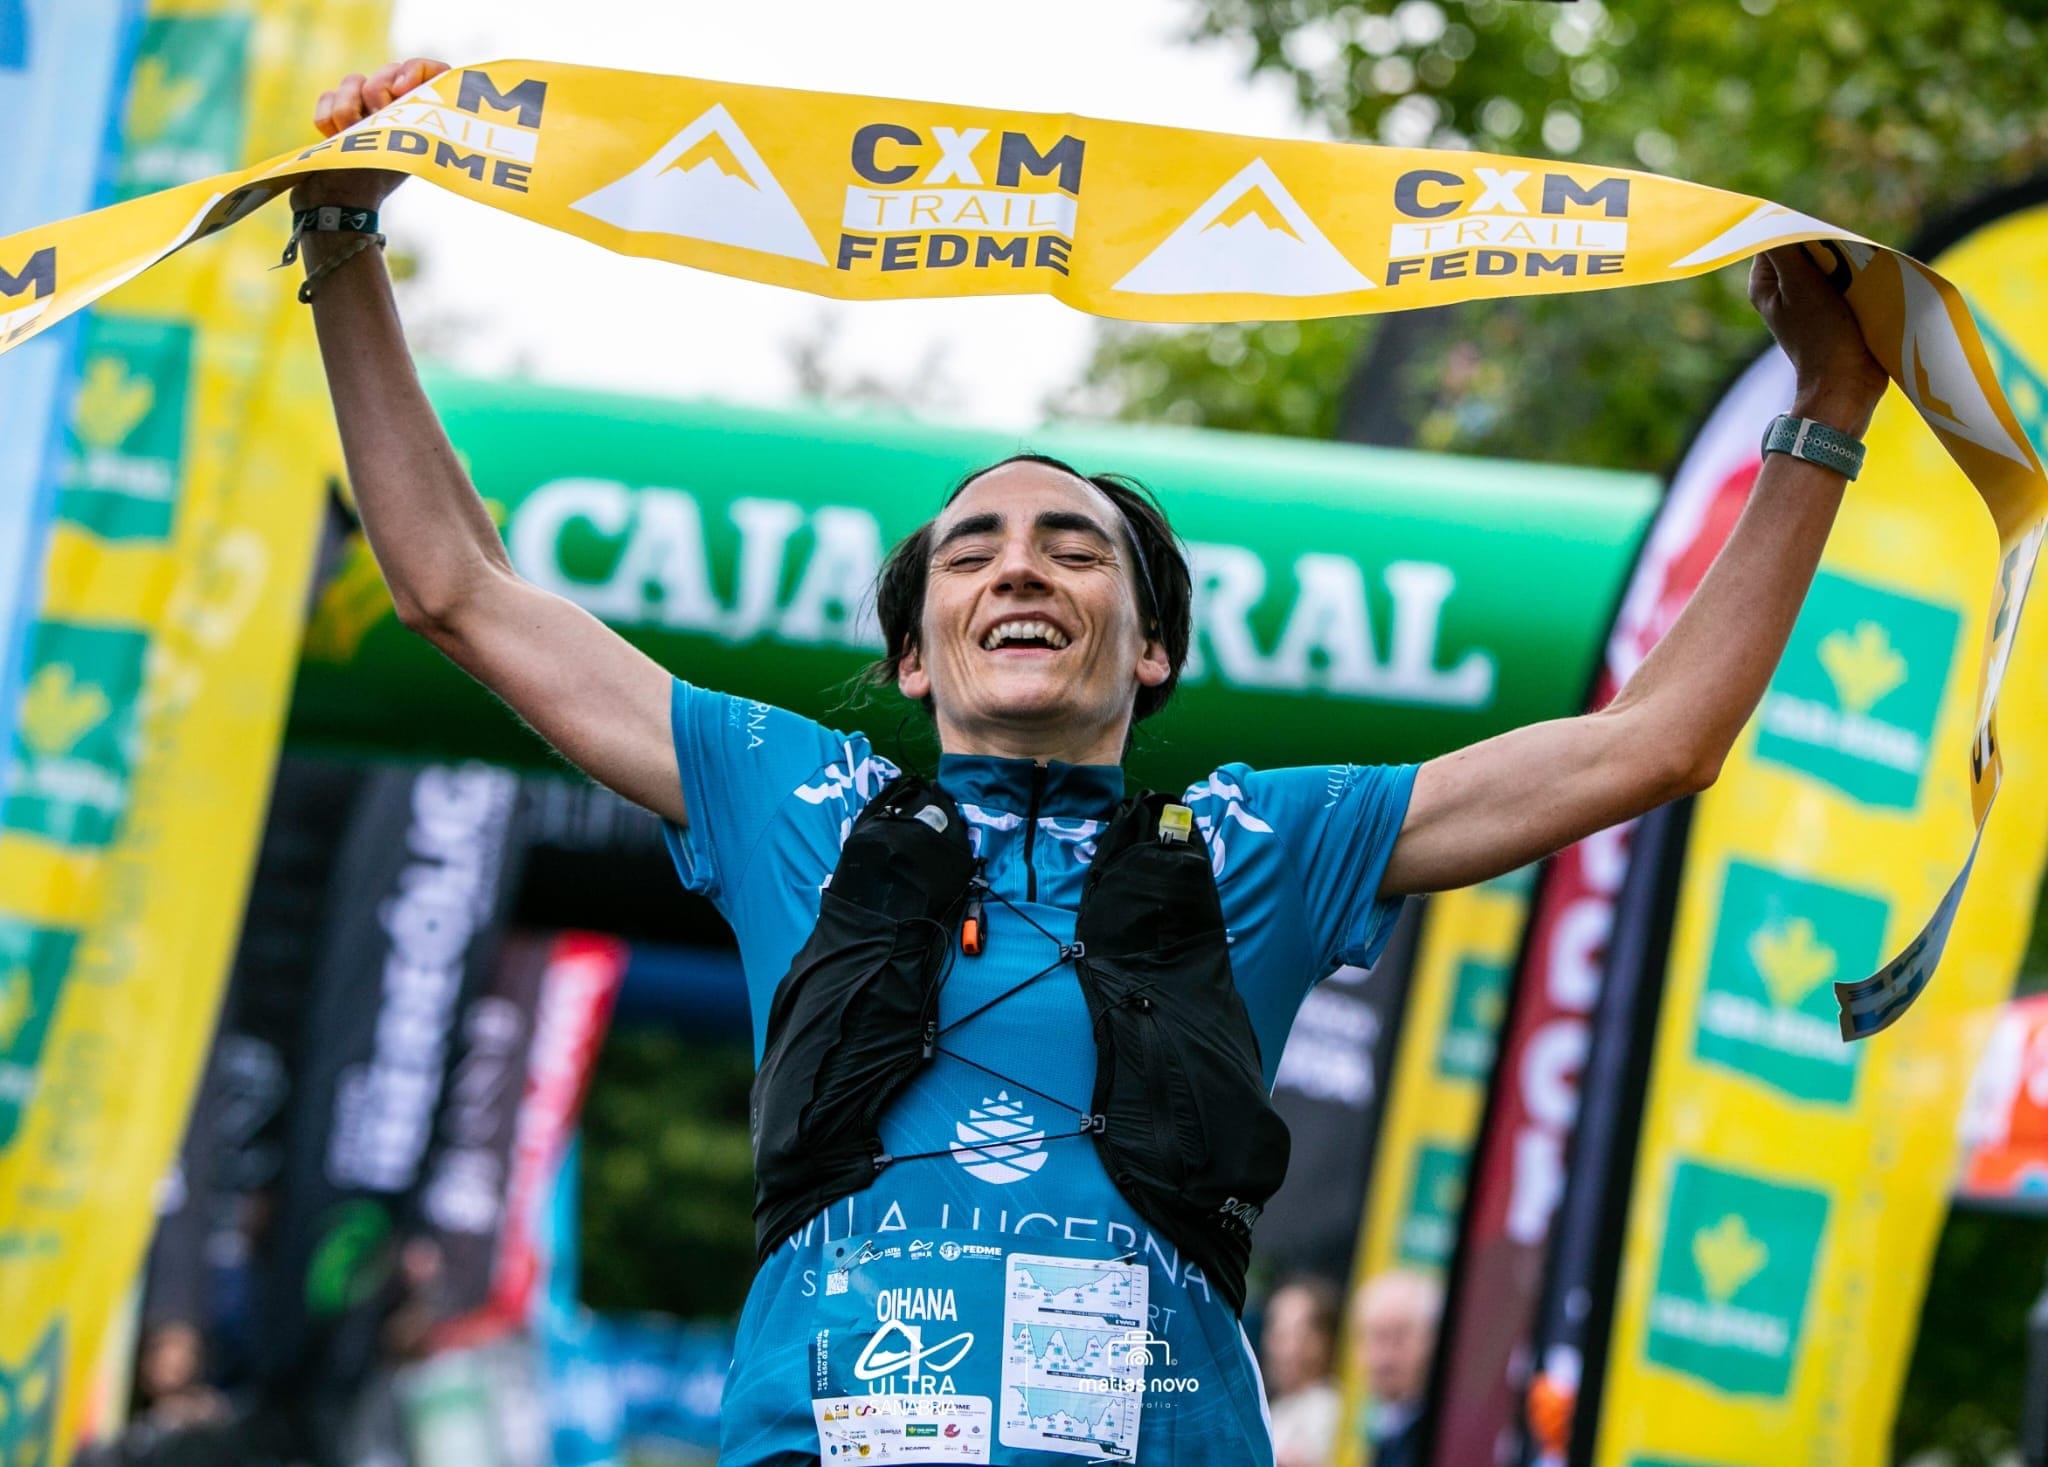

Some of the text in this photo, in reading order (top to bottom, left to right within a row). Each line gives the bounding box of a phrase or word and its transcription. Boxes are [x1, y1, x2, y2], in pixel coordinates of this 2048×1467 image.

[369, 106, 515, 155] RAIL
[297, 129, 533, 194] FEDME
[851, 123, 1086, 196] CXM
[867, 194, 1057, 226] TRAIL
[1393, 167, 1631, 218] CXM
[836, 233, 1073, 277] FEDME
[1412, 219, 1606, 250] TRAIL
[1385, 249, 1626, 287] FEDME
[508, 476, 1495, 709] CAJA RAL
[962, 1244, 1002, 1256] FEDME
[876, 1287, 959, 1323] OIHANA
